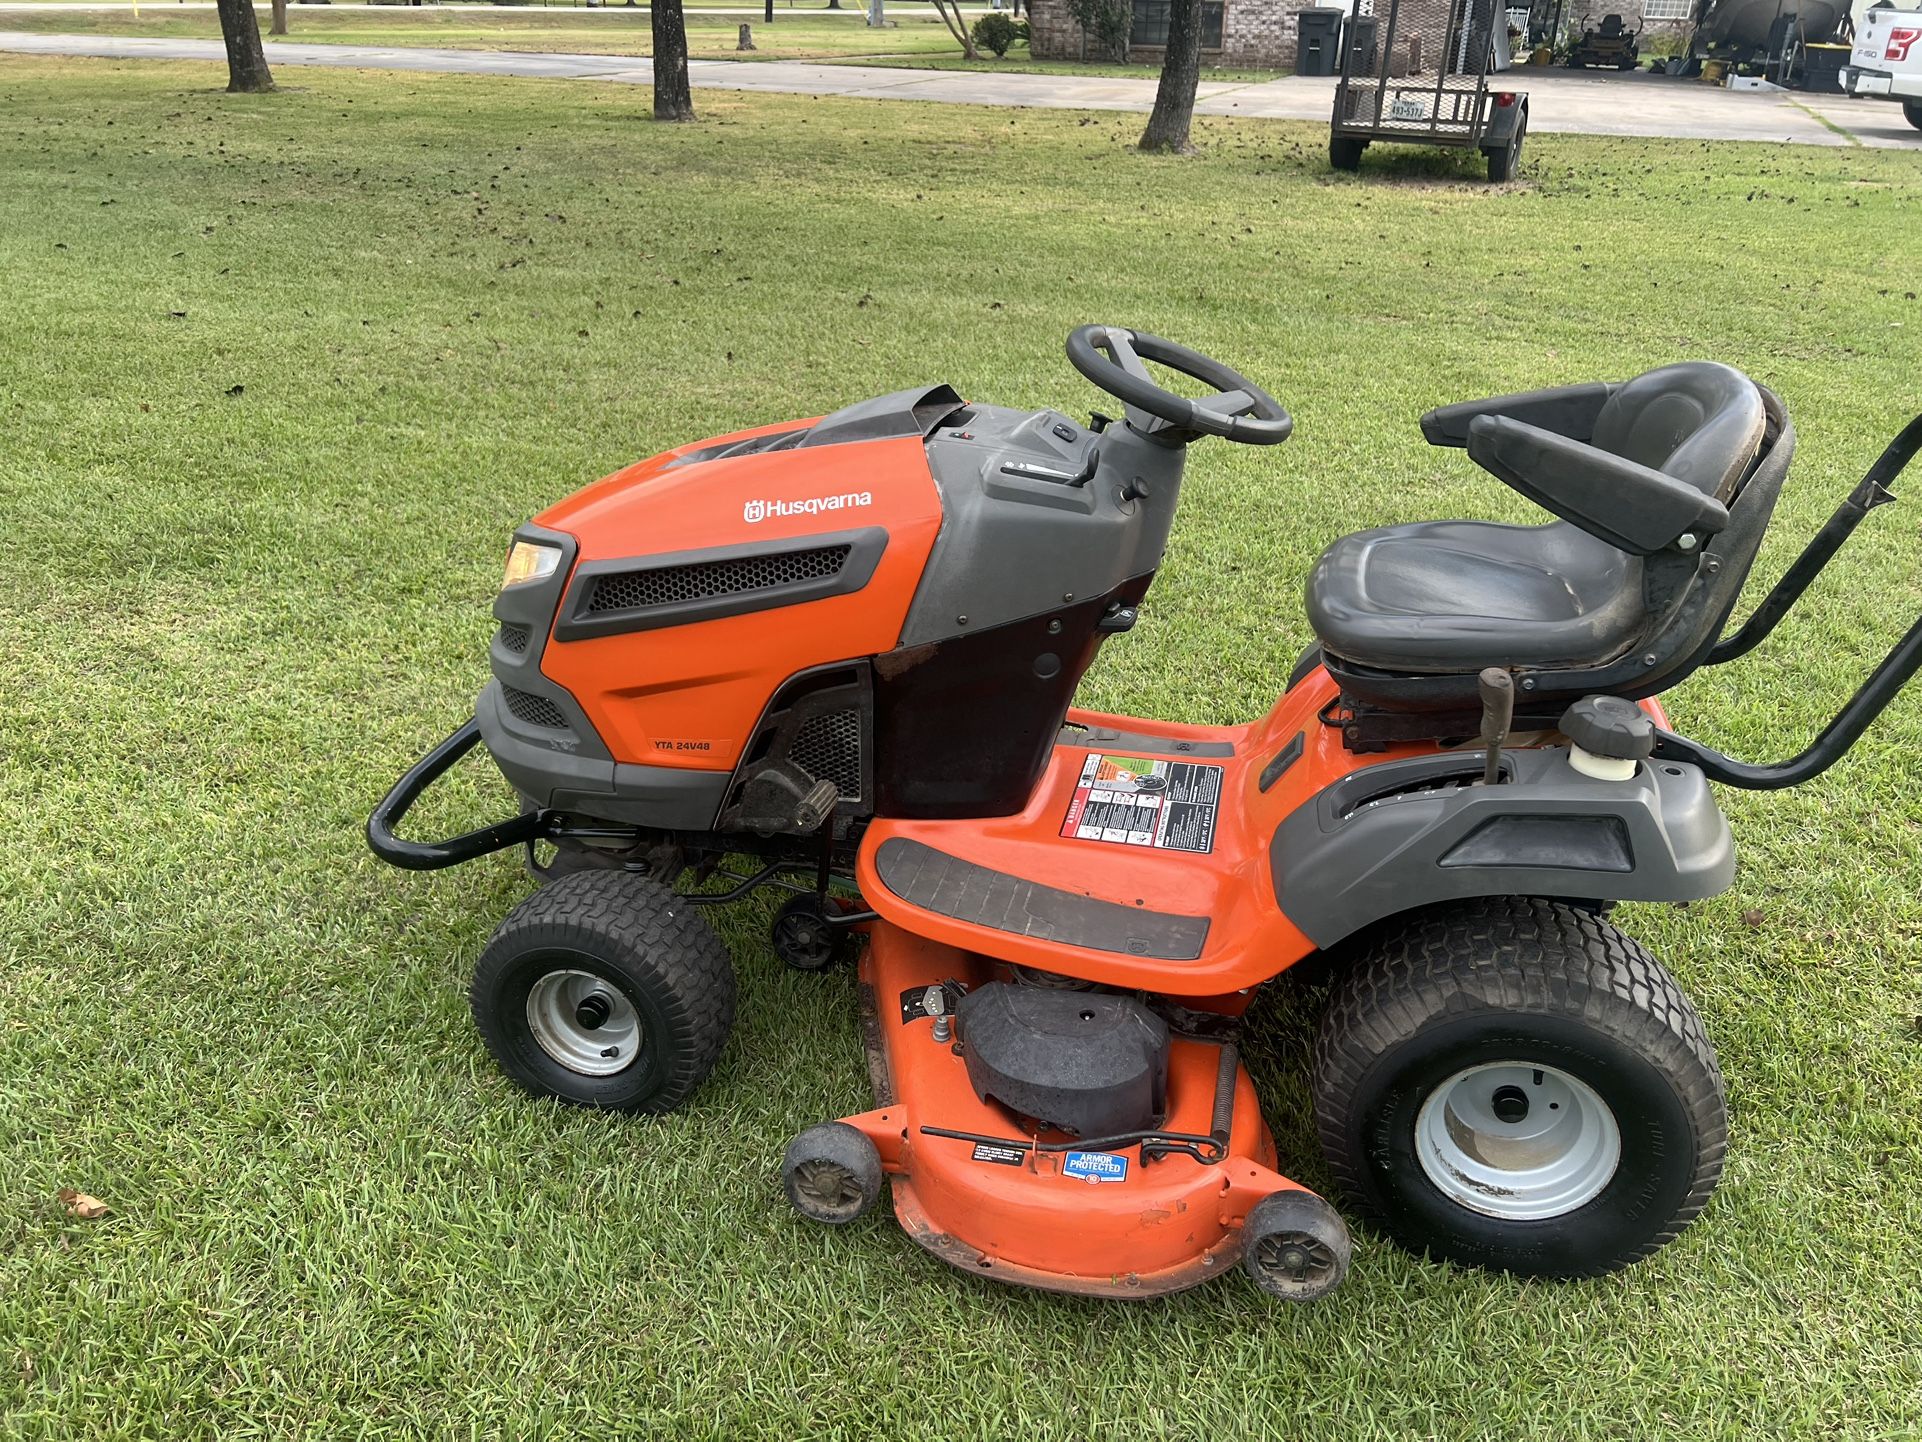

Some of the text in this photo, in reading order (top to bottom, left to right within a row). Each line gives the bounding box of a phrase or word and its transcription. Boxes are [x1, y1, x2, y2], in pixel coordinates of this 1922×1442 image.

[1857, 49, 1877, 57] F-150
[766, 491, 872, 517] Husqvarna
[655, 741, 710, 751] YTA 24V48
[1080, 1154, 1113, 1164] ARMOR
[1069, 1160, 1121, 1173] PROTECTED
